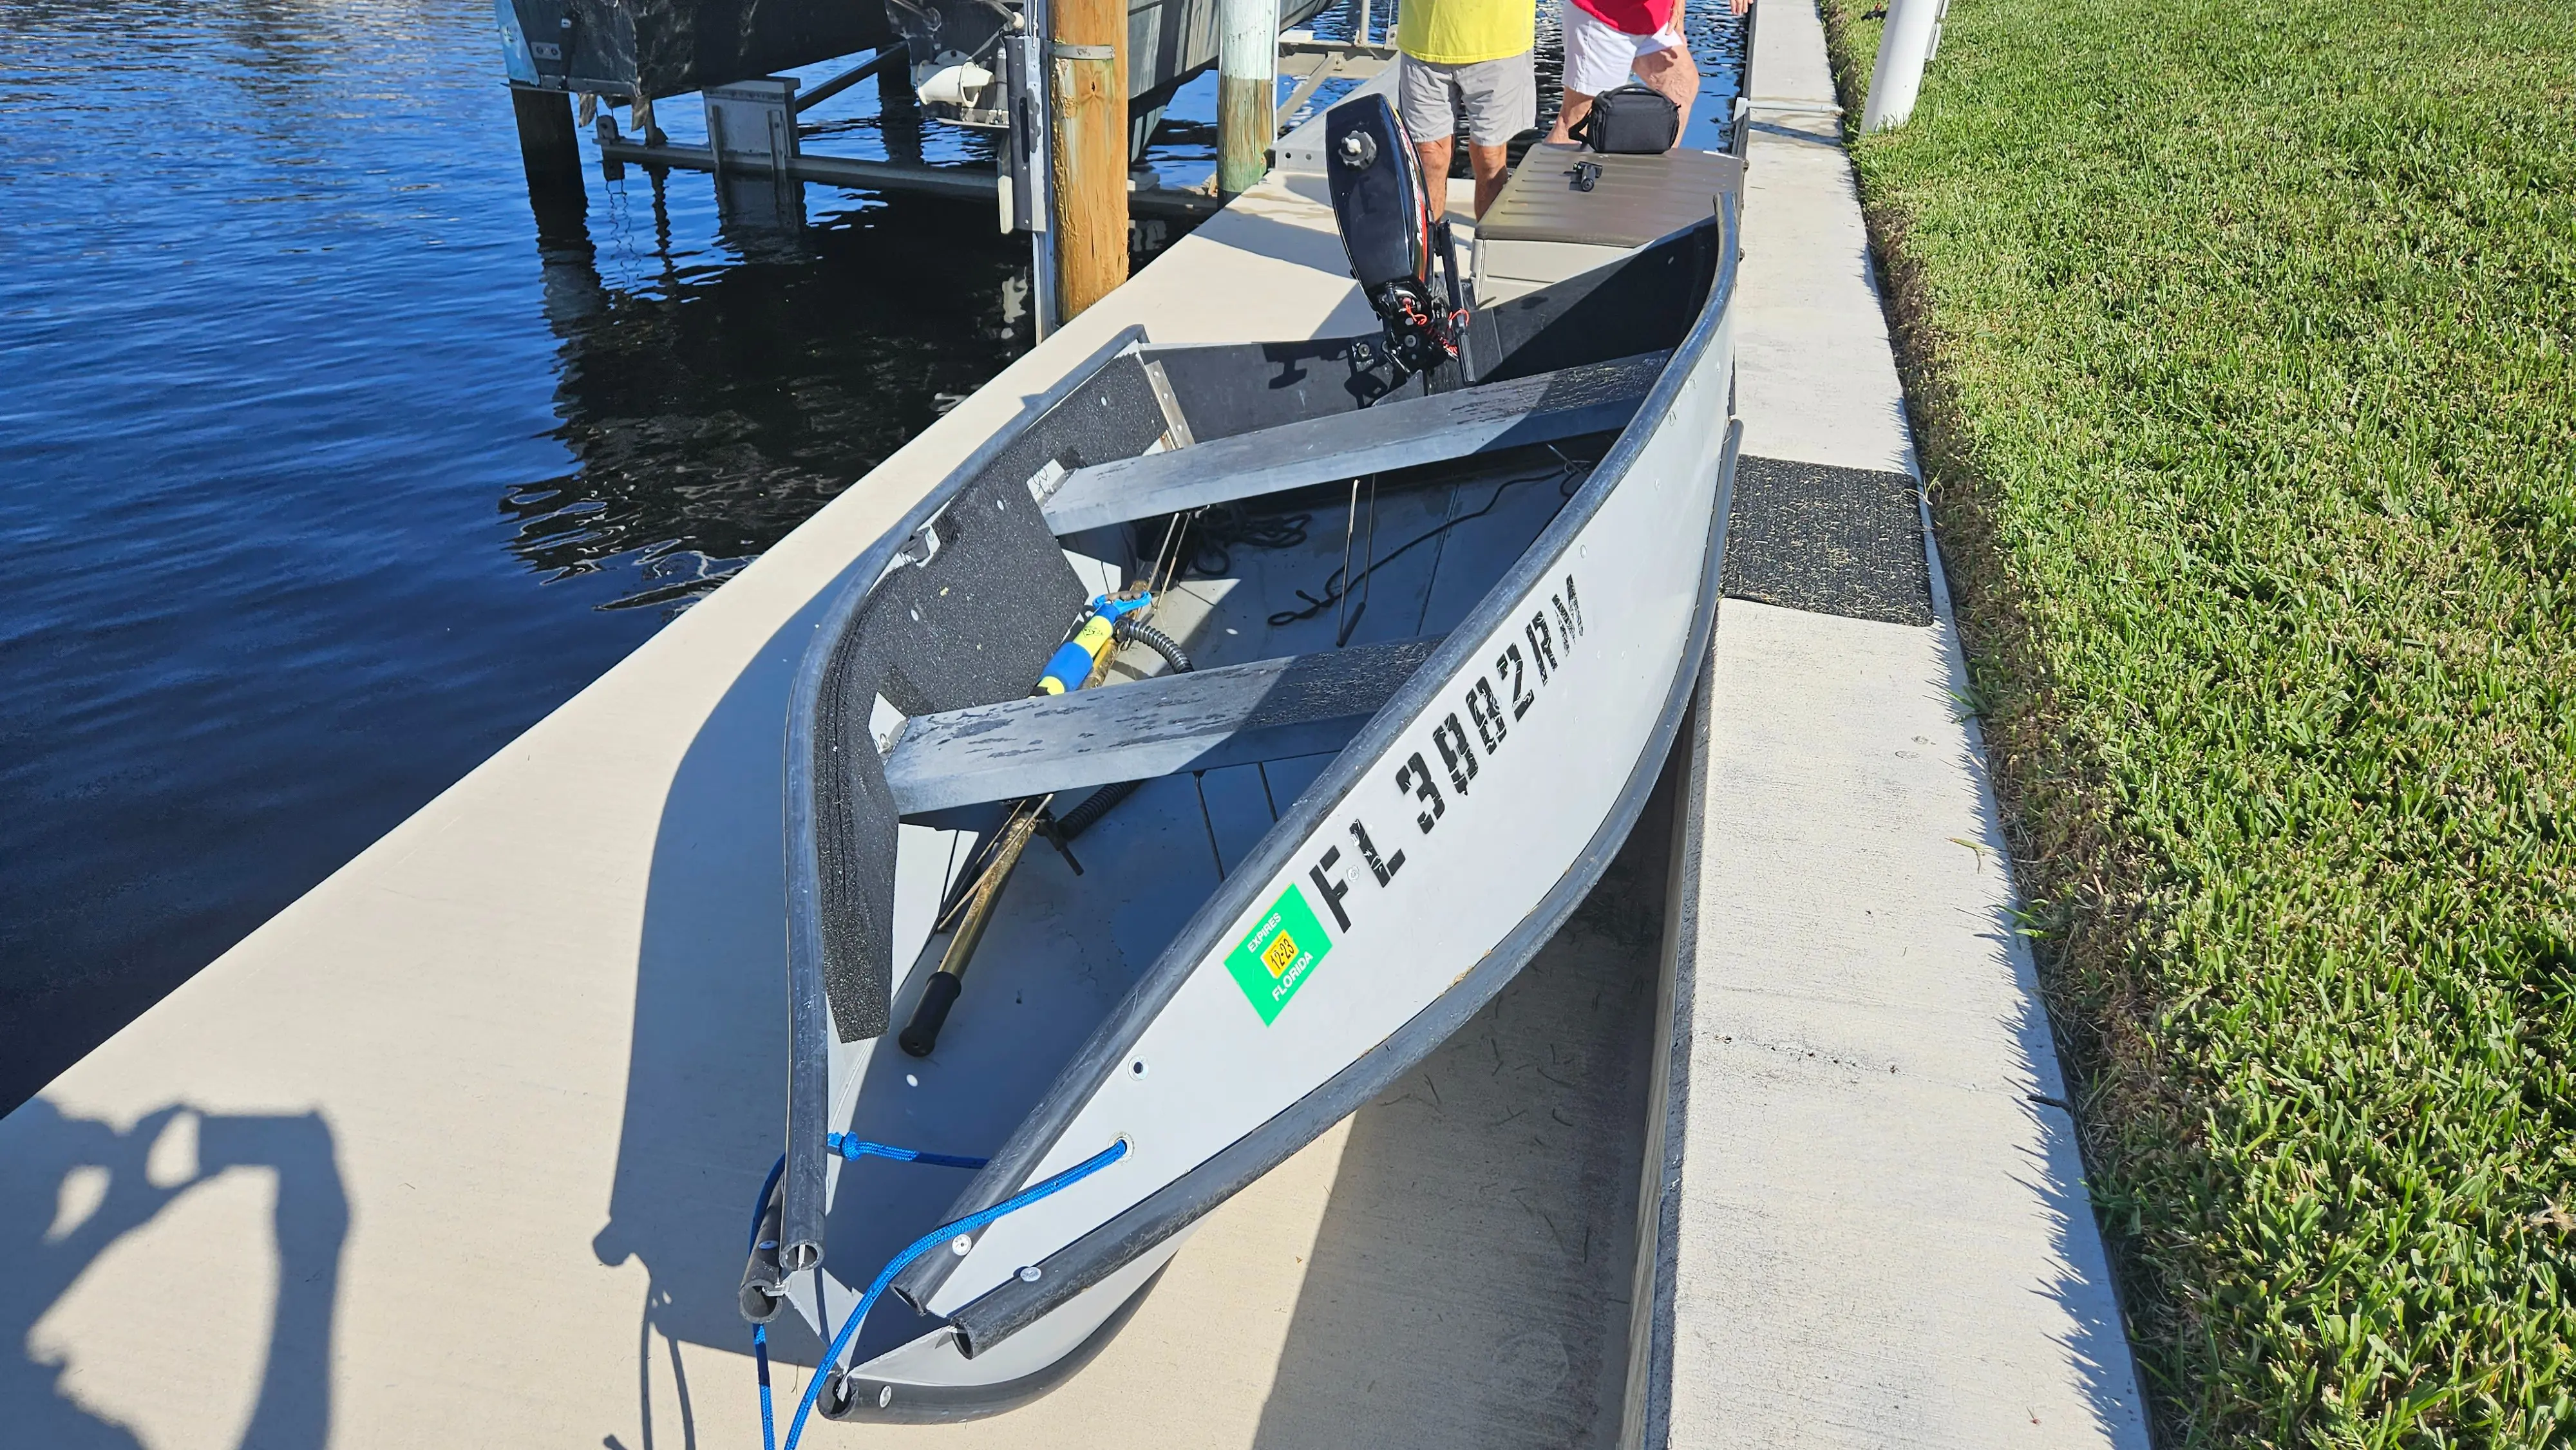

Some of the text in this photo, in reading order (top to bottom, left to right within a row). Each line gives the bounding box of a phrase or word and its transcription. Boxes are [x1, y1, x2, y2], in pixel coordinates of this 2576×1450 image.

[1247, 912, 1282, 953] EXPIRES
[1270, 938, 1294, 970] 12-23
[1272, 951, 1314, 1002] FLORIDA
